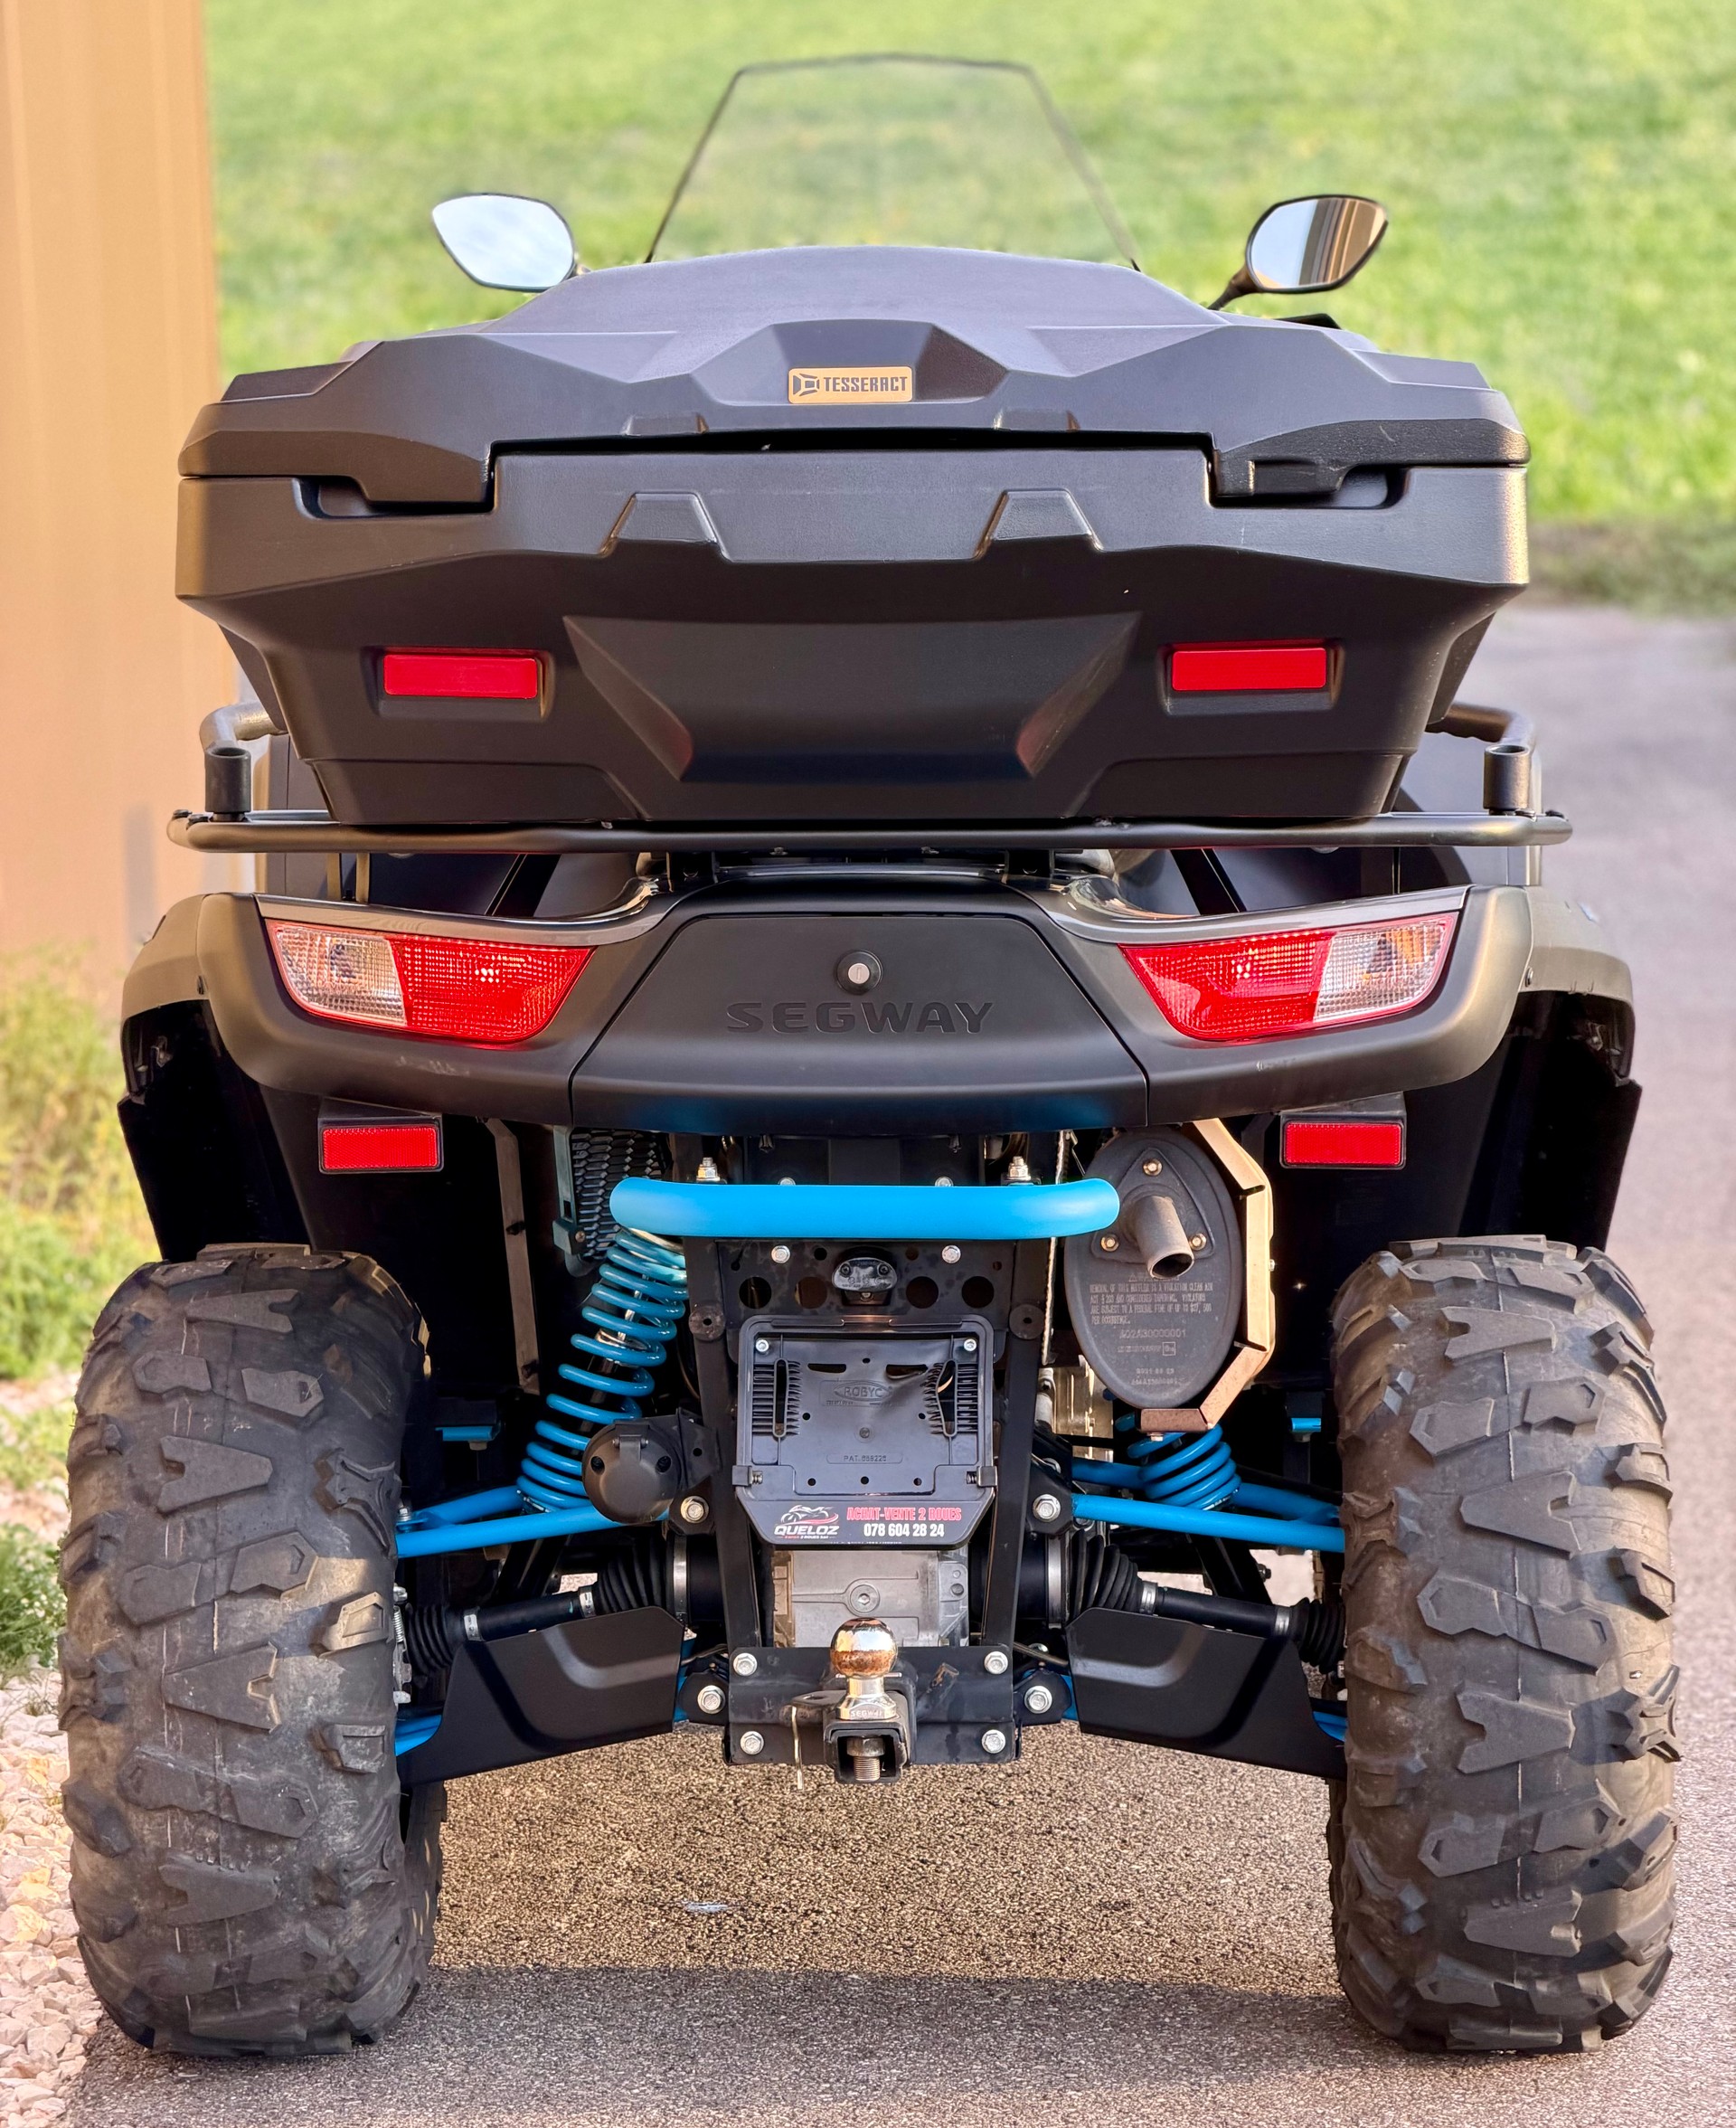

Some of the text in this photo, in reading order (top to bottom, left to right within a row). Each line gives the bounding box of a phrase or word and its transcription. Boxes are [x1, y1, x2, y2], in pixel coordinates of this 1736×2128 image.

[824, 376, 907, 392] TESSERACT
[726, 1002, 993, 1034] SEGWAY
[844, 1386, 883, 1397] ROBYC
[846, 1507, 962, 1521] ACHAT-VENTE 2 ROUES
[774, 1525, 840, 1536] QUELOZ
[863, 1523, 945, 1537] 078 604 28 24
